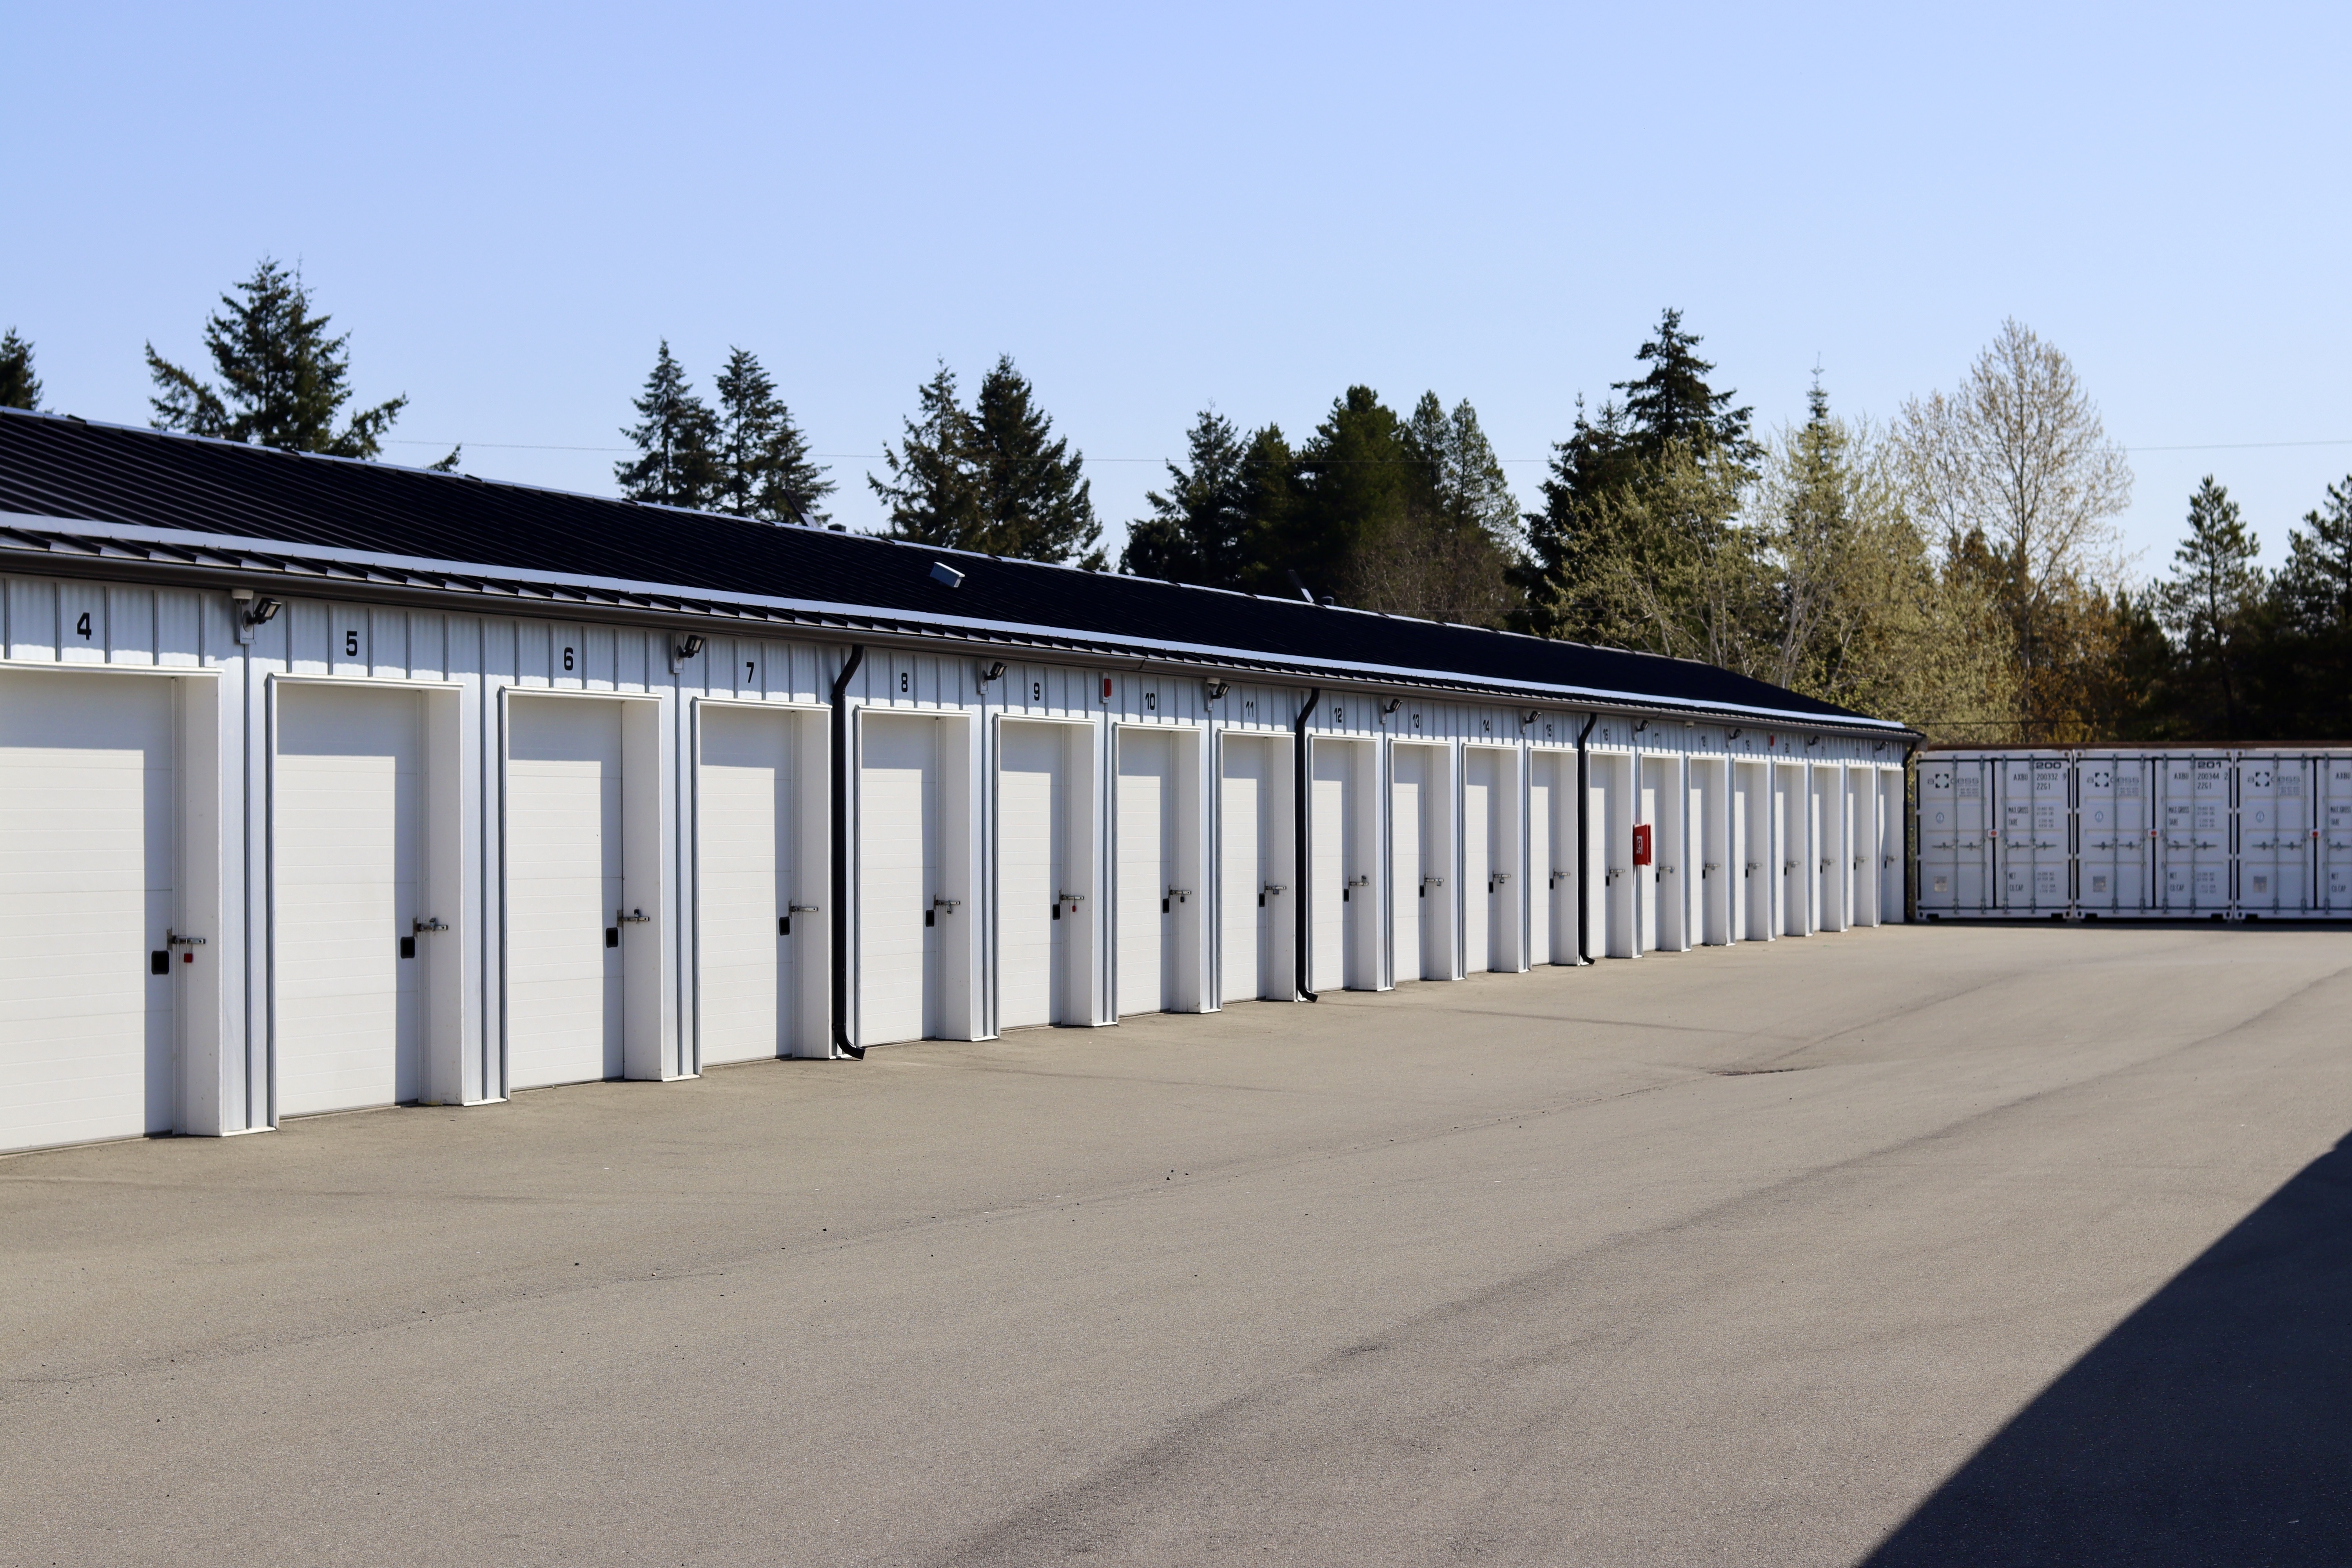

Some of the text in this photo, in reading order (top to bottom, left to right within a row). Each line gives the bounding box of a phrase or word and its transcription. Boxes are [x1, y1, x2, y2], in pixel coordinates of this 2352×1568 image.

[77, 612, 92, 641] 4
[346, 630, 358, 657] 5
[564, 647, 573, 671] 6
[746, 661, 754, 683] 7
[901, 672, 908, 693] 8
[1033, 682, 1040, 701] 9
[1145, 693, 1155, 710] 10
[1246, 701, 1254, 718] 11
[1334, 707, 1342, 723] 12
[1412, 713, 1419, 729] 13
[1483, 719, 1490, 733] 14
[1546, 724, 1552, 737] 15
[1603, 728, 1608, 741] 16
[2224, 772, 2228, 780] 2
